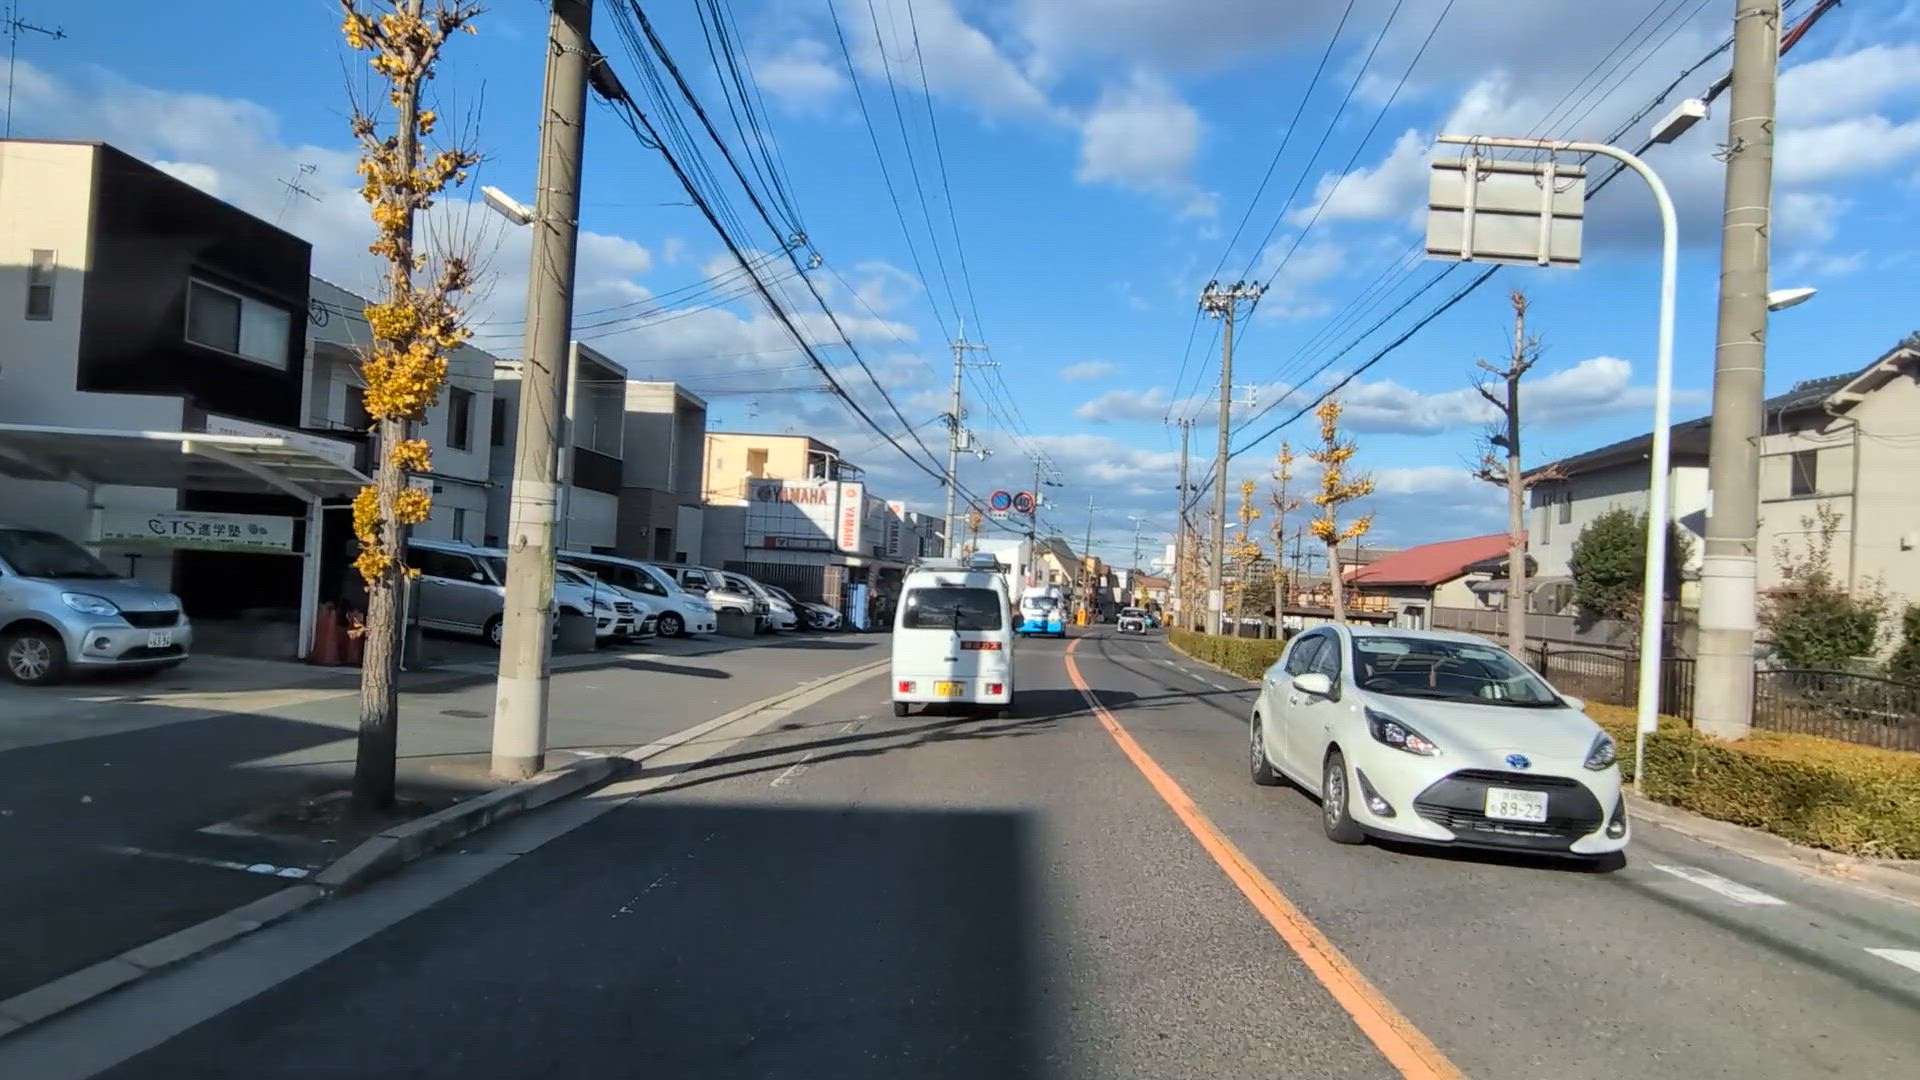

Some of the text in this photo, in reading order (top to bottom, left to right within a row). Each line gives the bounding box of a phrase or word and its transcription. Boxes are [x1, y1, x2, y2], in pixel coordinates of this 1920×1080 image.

[773, 486, 828, 505] YAMAHA
[843, 506, 856, 548] YAMAHA
[1500, 801, 1542, 819] 89-22
